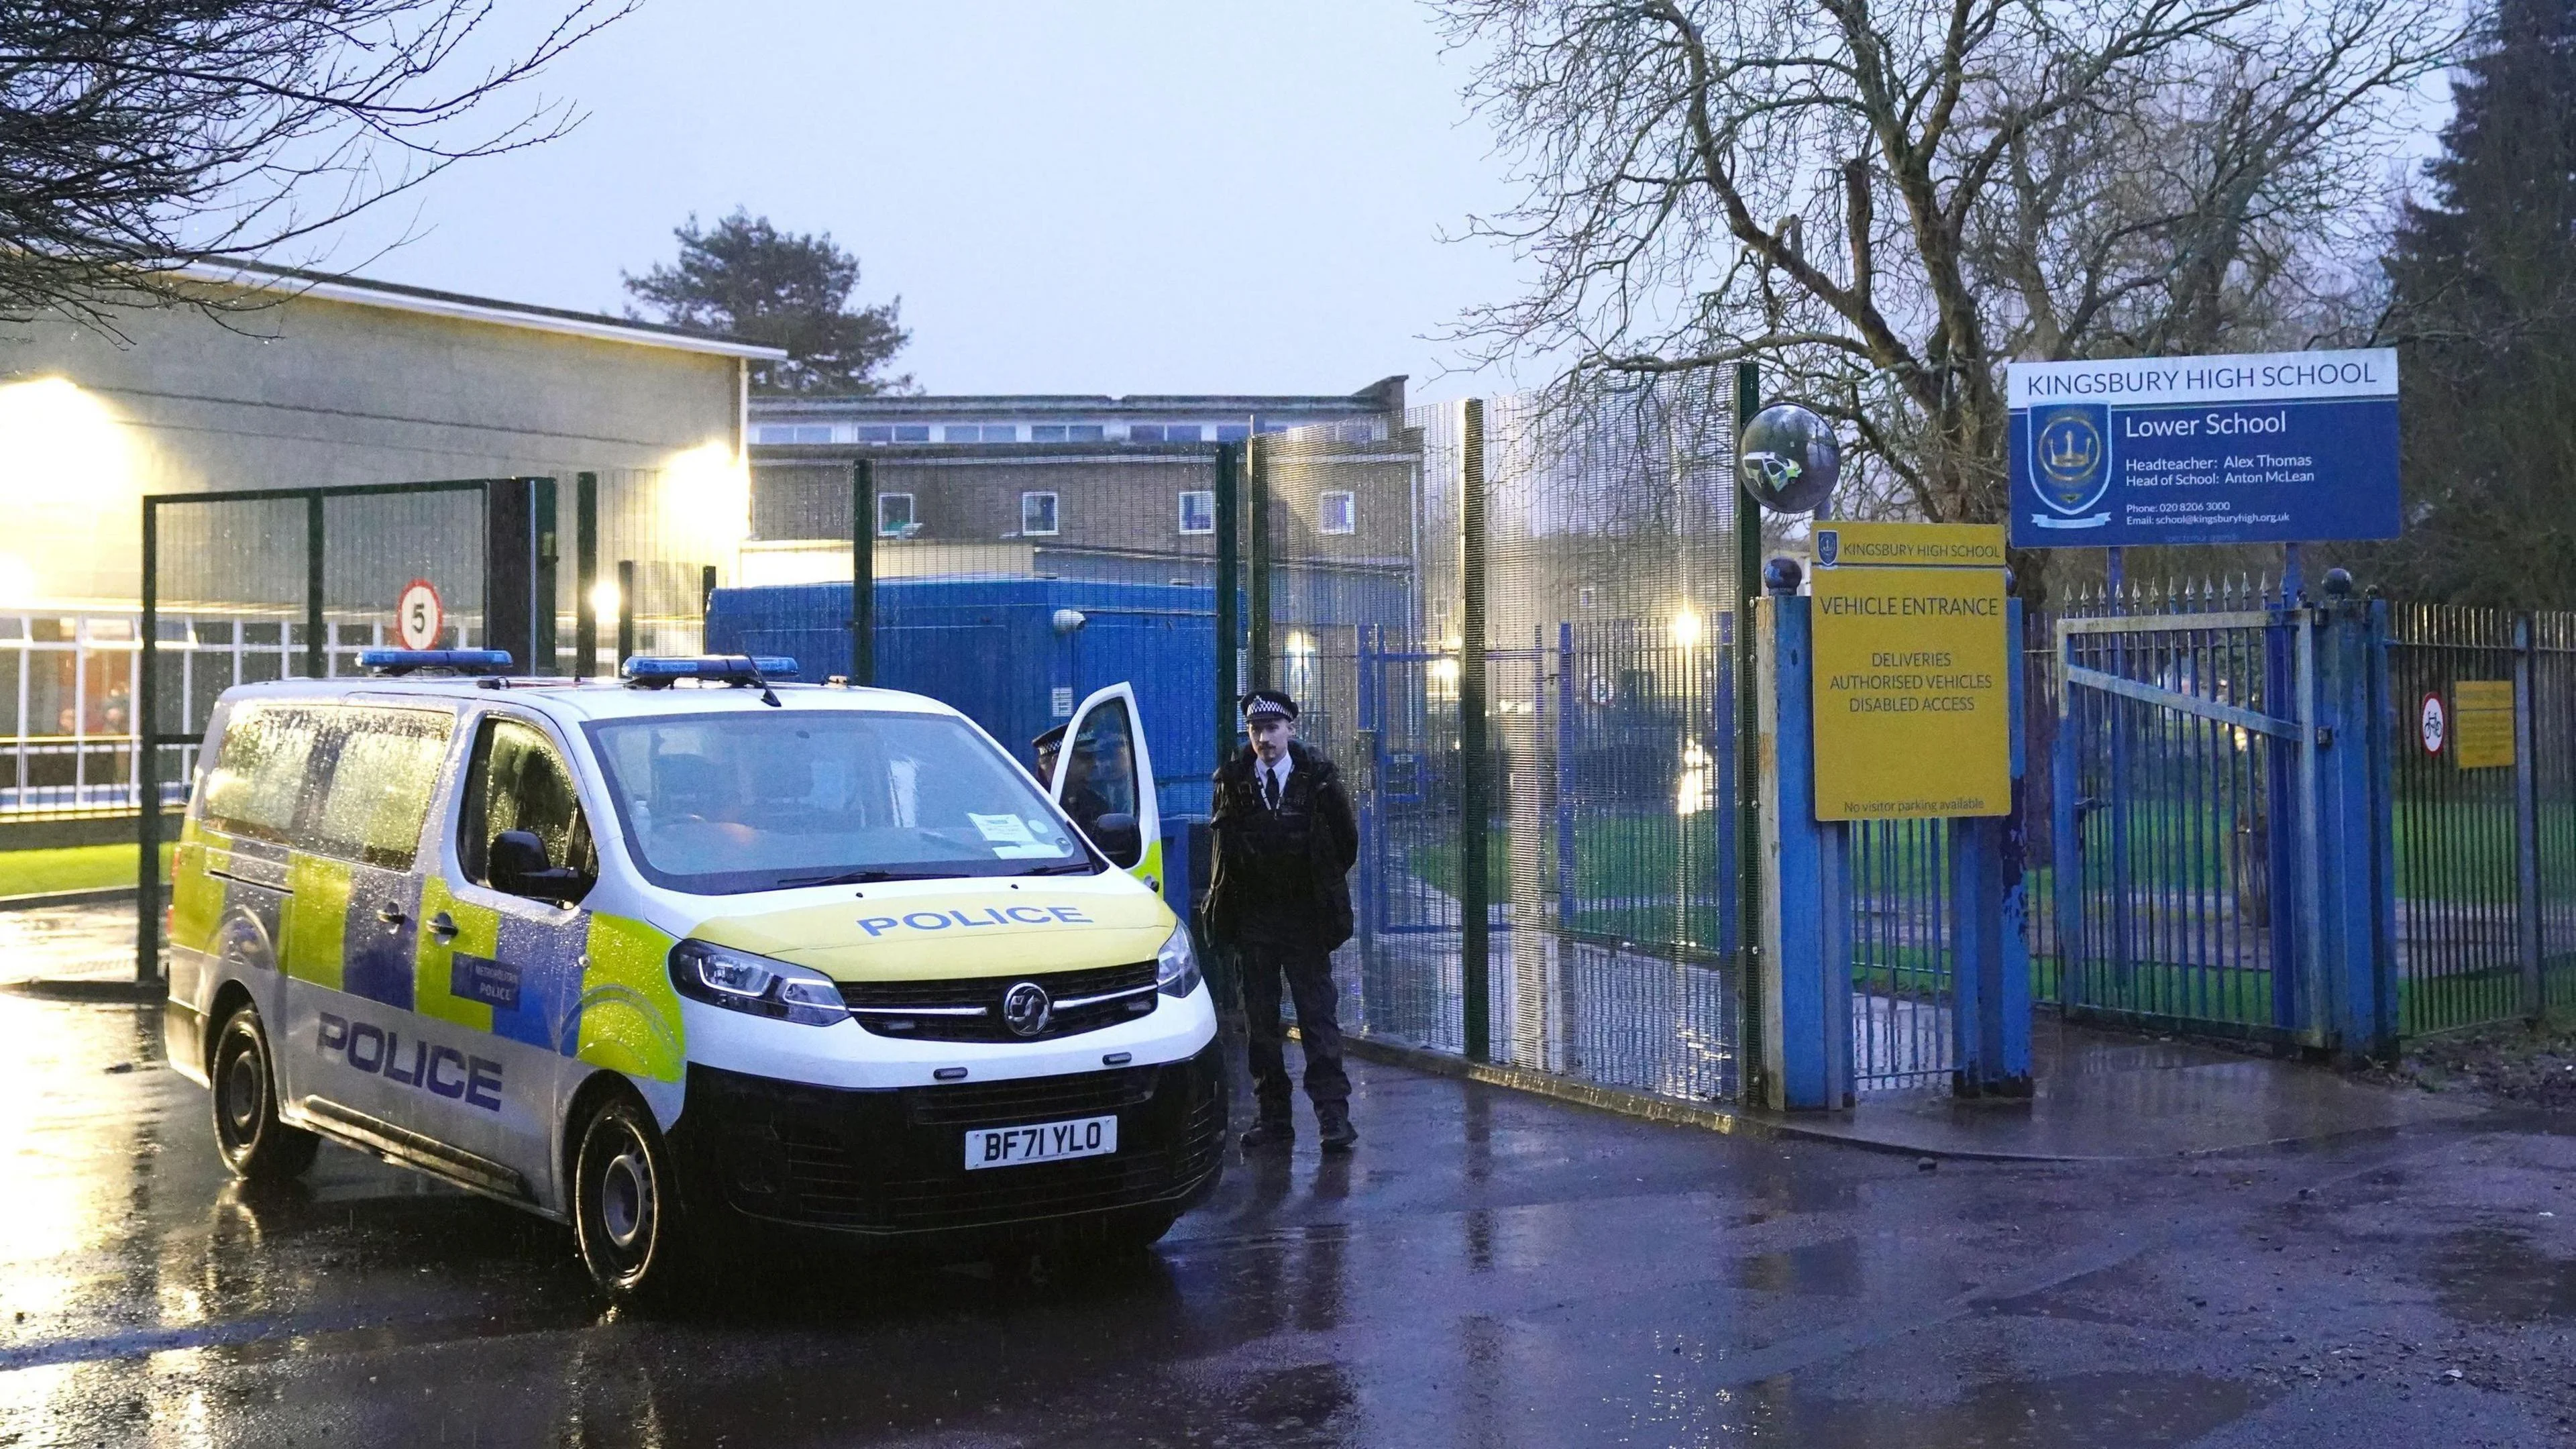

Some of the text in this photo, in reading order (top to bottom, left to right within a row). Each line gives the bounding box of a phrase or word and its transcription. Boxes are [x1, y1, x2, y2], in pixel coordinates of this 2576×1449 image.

[2029, 362, 2377, 396] KINGSBURY HIGH SCHOOL
[2126, 410, 2286, 437] Lower School
[2126, 454, 2312, 471] Headteacher: Alex Thomas
[2126, 471, 2314, 486] Head of School: Anton McLean
[2127, 502, 2231, 513] Phone: 020 8206 3000
[2127, 513, 2290, 525] Email: school@kingsburyhigh.org.uk
[1843, 543, 2000, 558] KINGSBURY HIGH SCHOOL
[1820, 596, 1998, 616] VEHICLE ENTRANCE
[413, 602, 425, 633] 5
[1872, 653, 1951, 667] DELIVERIES
[1829, 674, 1992, 690] AUTHORISED VEHICLES
[1849, 696, 1975, 712] DISABLED ACCESS
[1845, 798, 1985, 814] No visitor parking available
[856, 906, 1094, 936] POLICE
[479, 982, 512, 1001] POLICE
[317, 1011, 503, 1112] POLICE
[984, 1122, 1102, 1161] BF71 YLO
